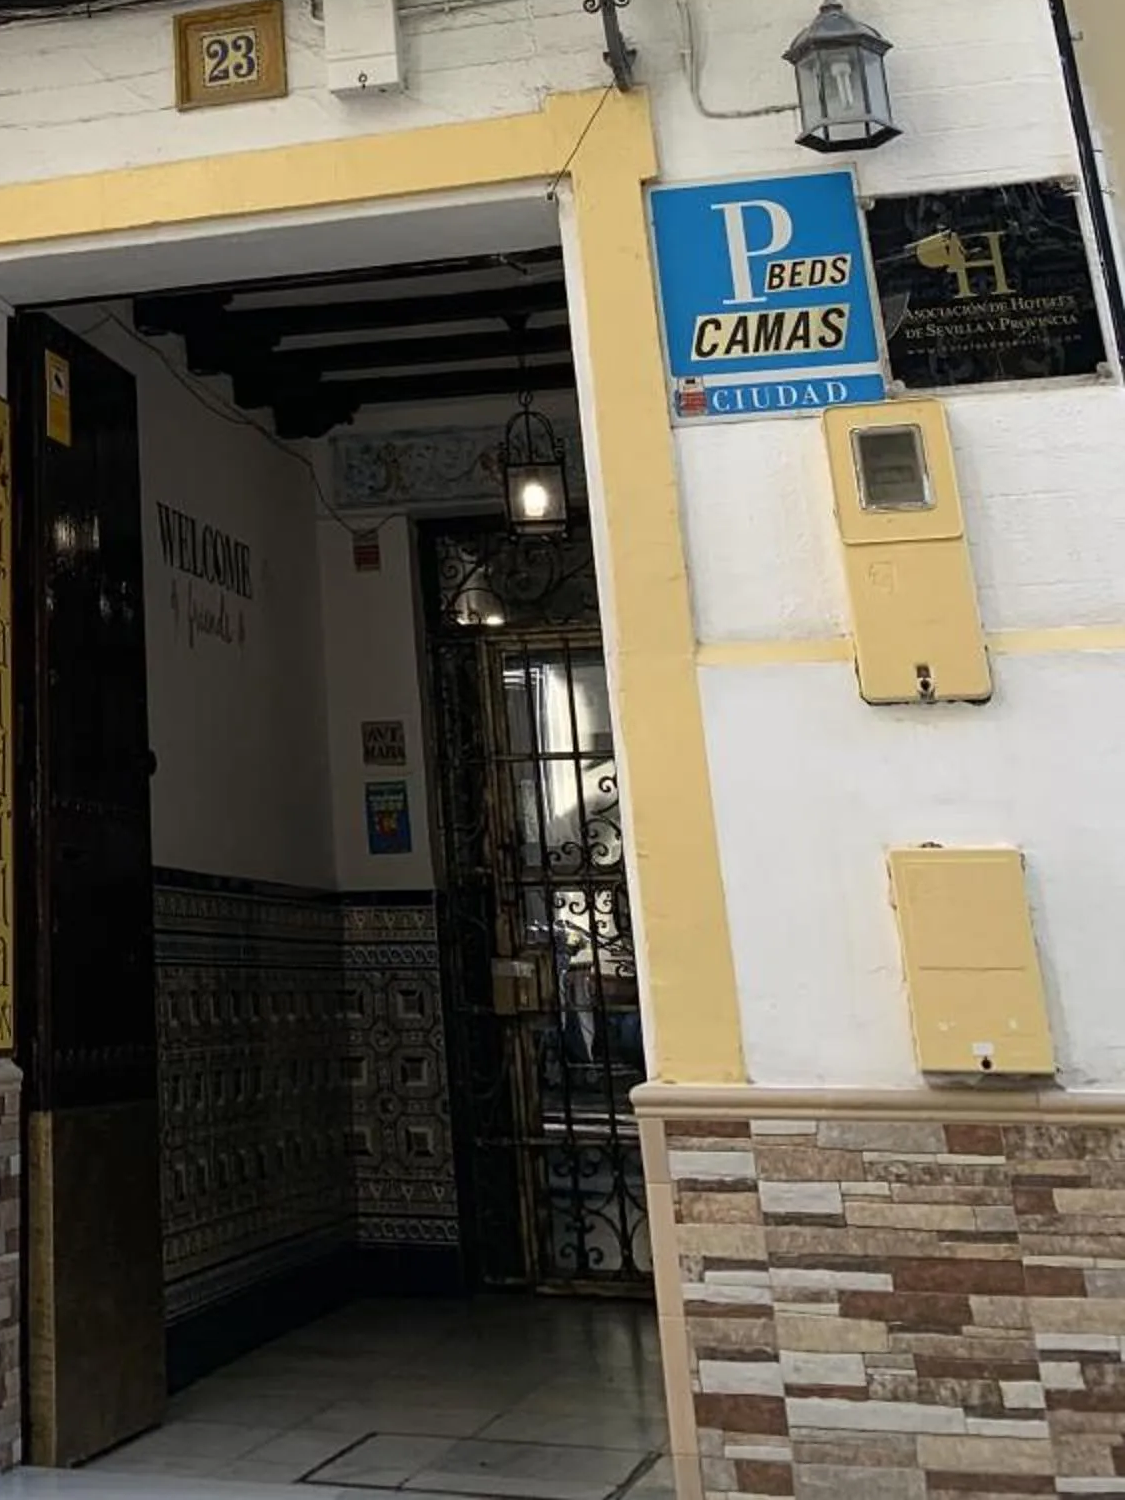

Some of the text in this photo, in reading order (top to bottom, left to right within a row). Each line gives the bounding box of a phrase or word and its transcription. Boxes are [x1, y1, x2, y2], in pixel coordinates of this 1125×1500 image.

[206, 35, 255, 82] 23
[711, 199, 793, 306] P
[766, 256, 849, 292] BEDS
[694, 306, 846, 359] CAMAS
[926, 322, 985, 337] SEVILLA
[999, 314, 1078, 331] PROVINCIA
[712, 380, 849, 413] CIUDAD
[156, 500, 254, 600] WELCOME
